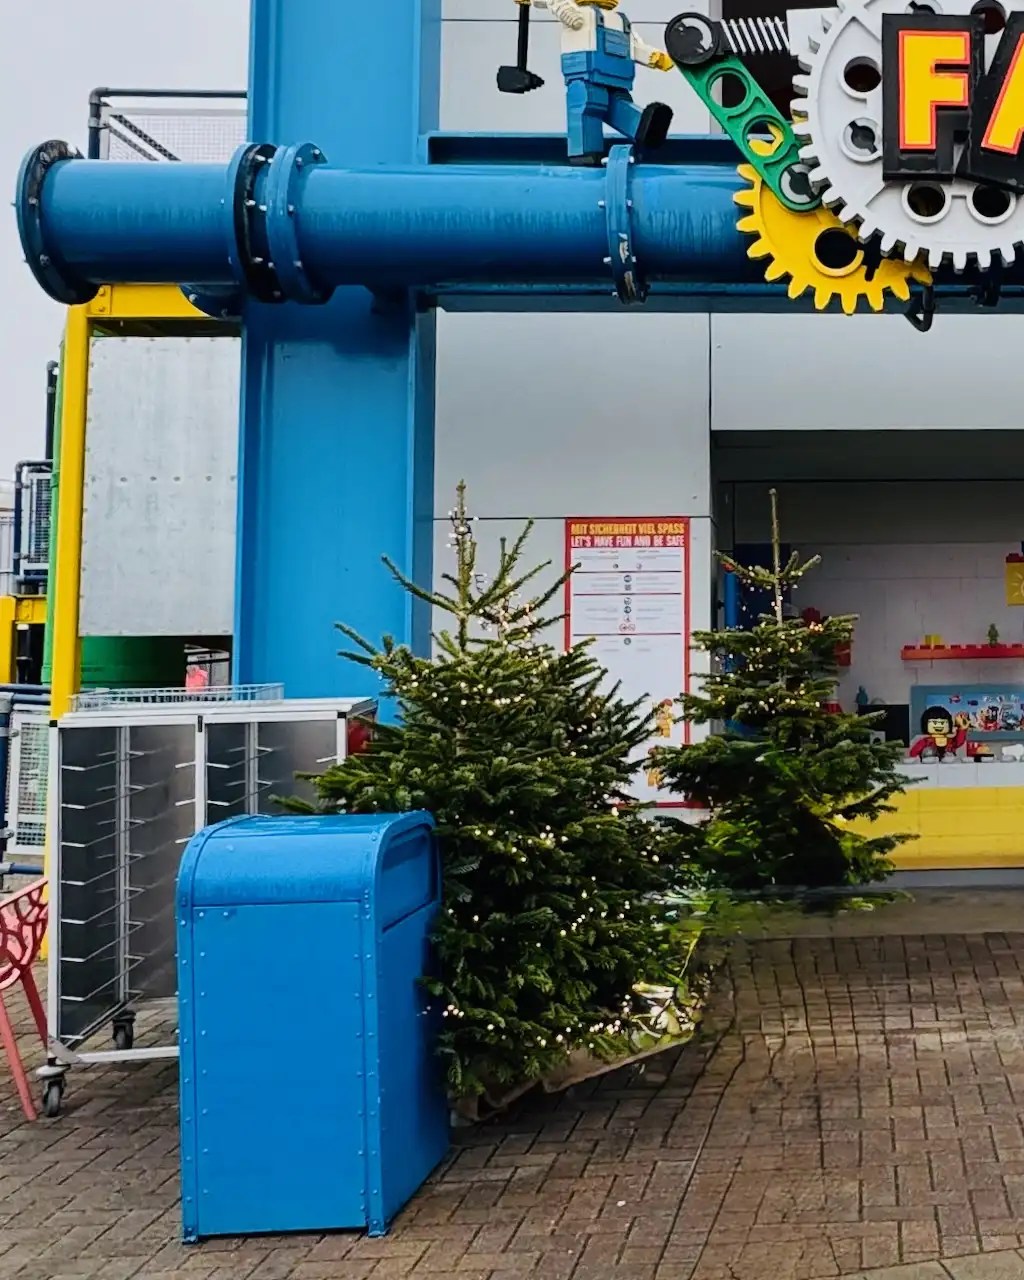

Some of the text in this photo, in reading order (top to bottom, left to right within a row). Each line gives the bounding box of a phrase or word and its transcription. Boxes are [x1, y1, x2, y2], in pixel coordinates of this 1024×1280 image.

[571, 523, 588, 535] MIT
[638, 523, 655, 535] VIEL
[657, 523, 685, 535] SPASS
[571, 535, 685, 548] LET'S HAVE FUN AND BE SAFE
